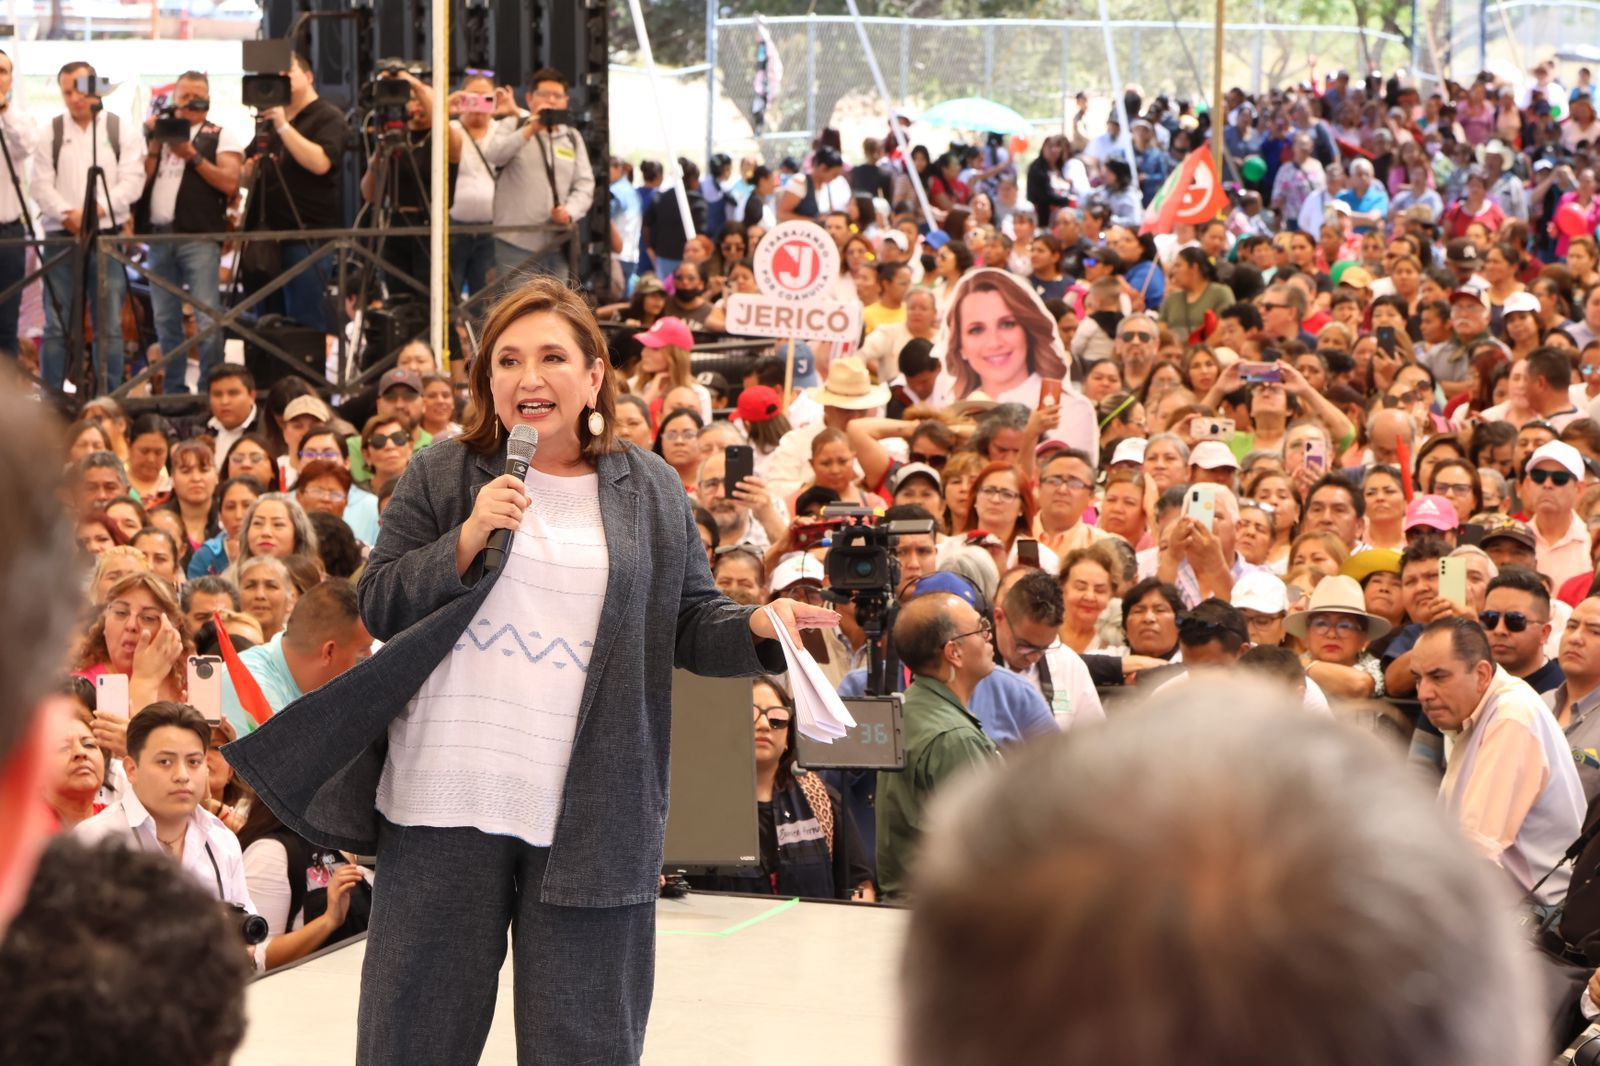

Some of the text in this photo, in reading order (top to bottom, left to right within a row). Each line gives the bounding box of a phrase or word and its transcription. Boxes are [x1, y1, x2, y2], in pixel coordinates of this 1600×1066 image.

[764, 230, 829, 258] TRABAJANDO
[762, 269, 828, 302] POR COAHUILA
[735, 303, 850, 333] JERICÓ
